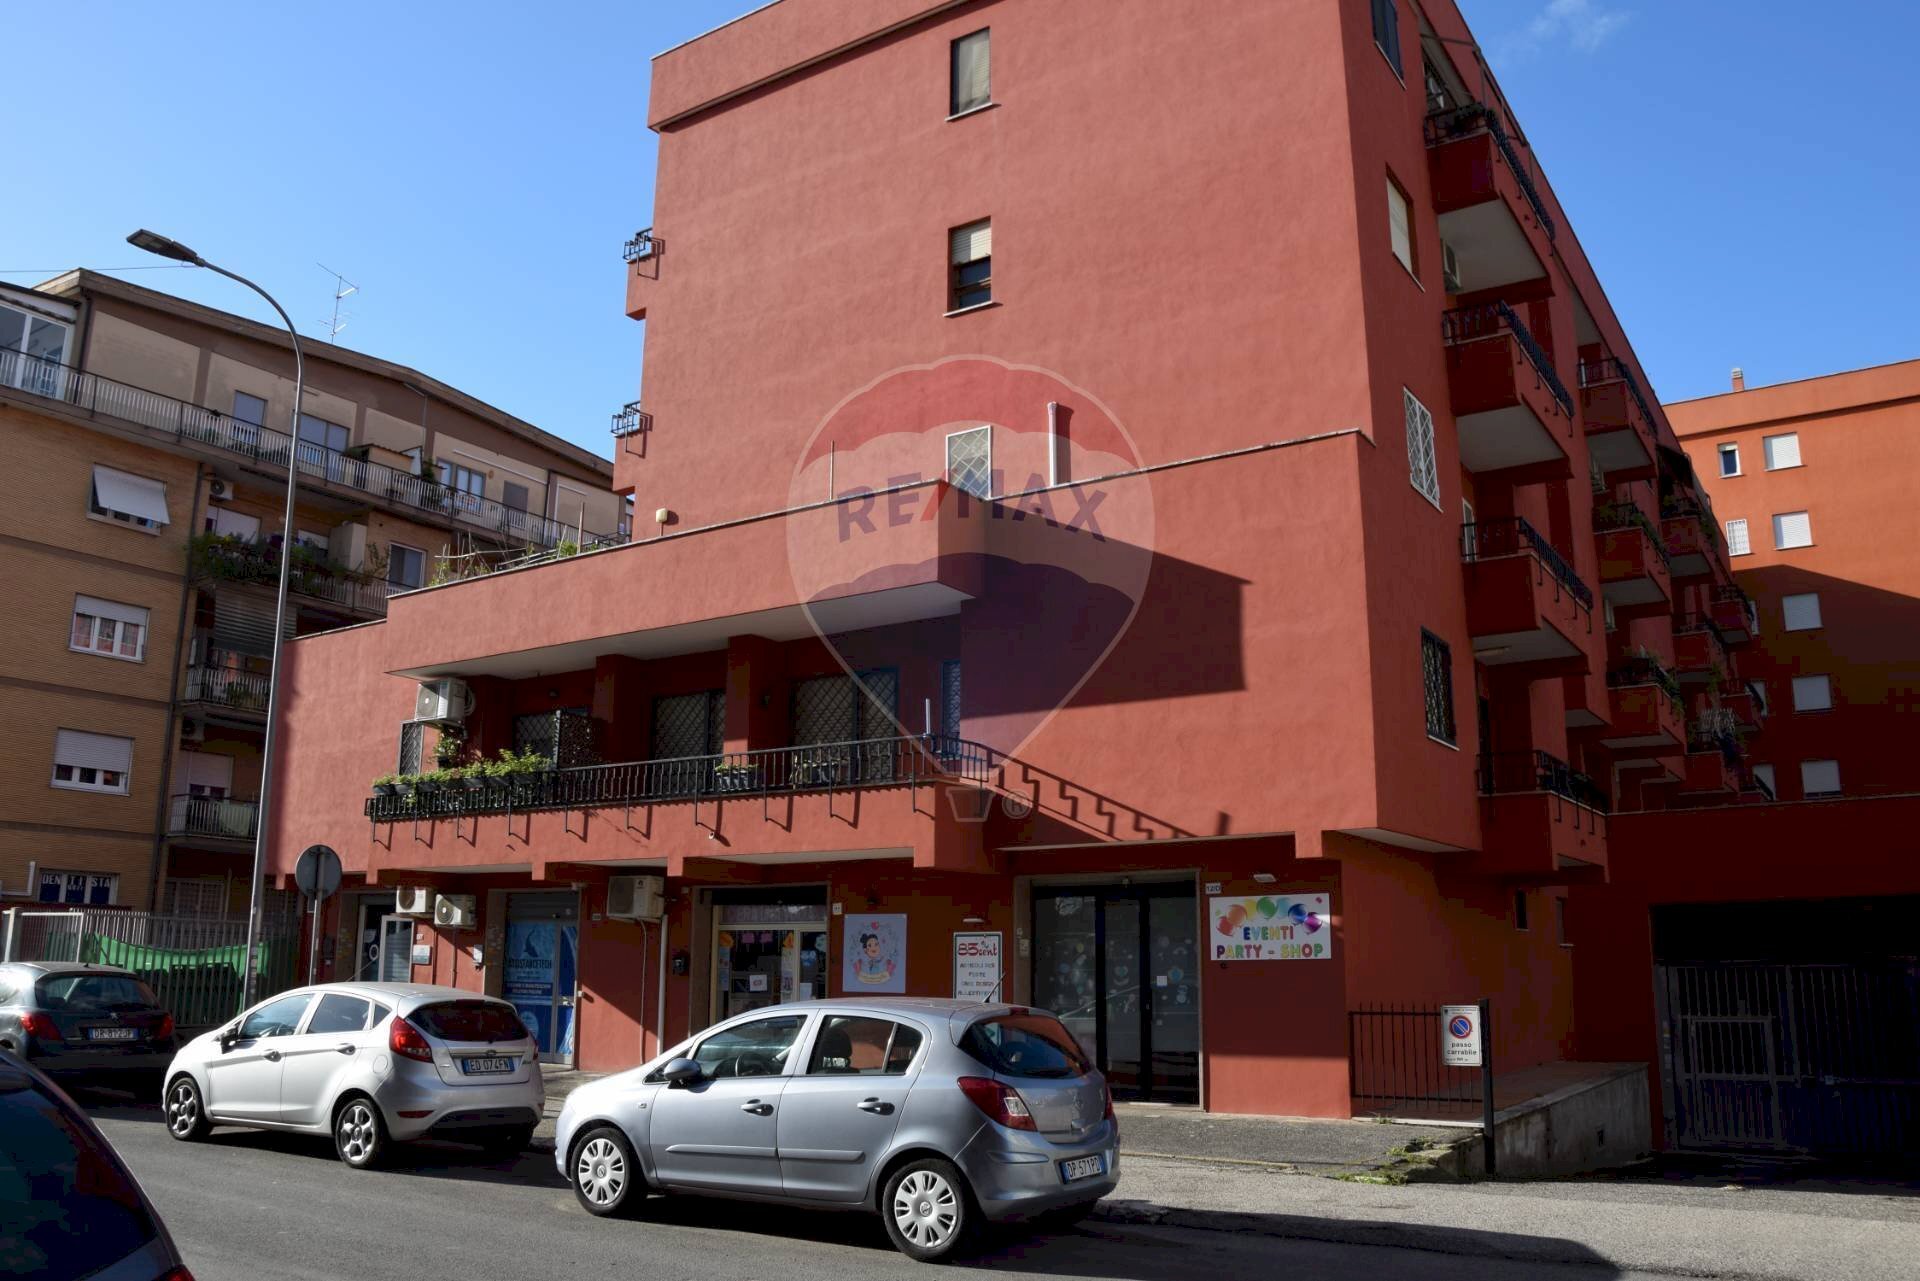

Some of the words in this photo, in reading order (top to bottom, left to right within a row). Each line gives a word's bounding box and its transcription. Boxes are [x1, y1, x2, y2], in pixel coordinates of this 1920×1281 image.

[1243, 926, 1294, 940] EVENTI
[1216, 944, 1262, 958] PARTY
[1280, 943, 1323, 958] SHOP
[470, 1059, 481, 1070] ED
